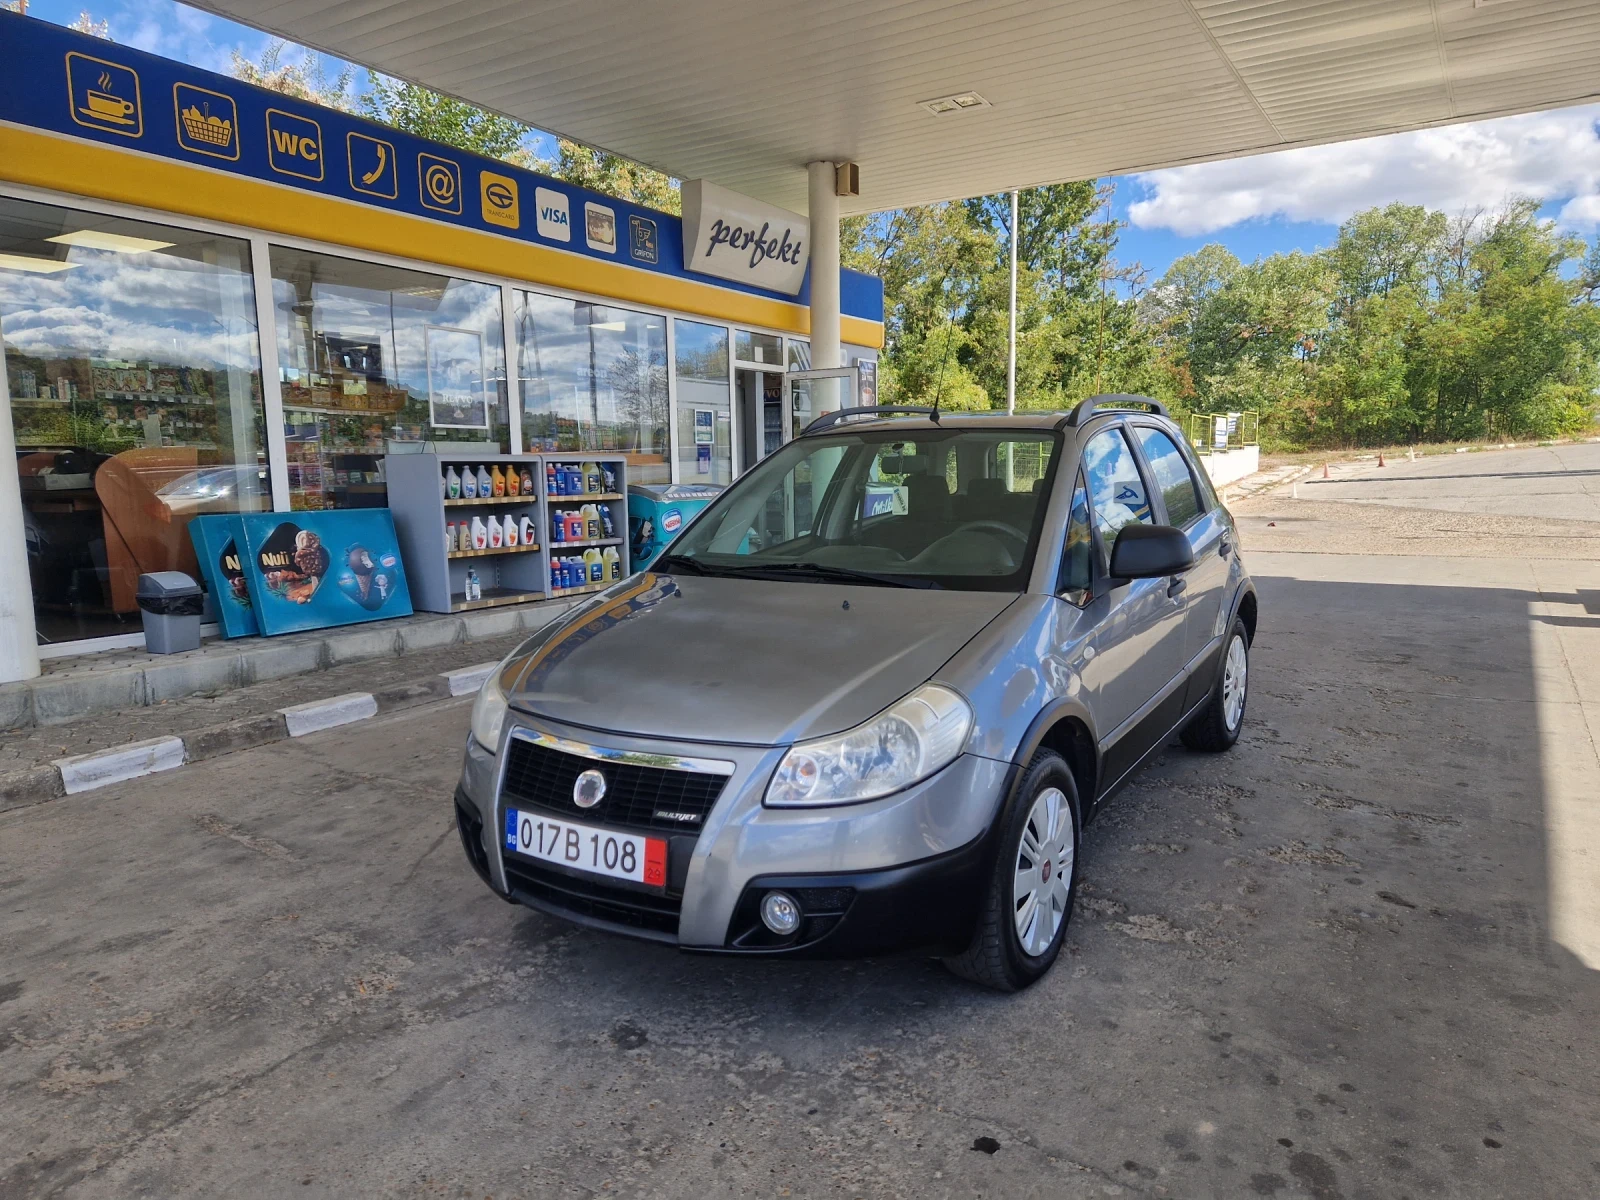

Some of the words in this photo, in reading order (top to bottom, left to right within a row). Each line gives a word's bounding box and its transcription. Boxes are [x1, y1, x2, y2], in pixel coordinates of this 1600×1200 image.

[273, 129, 318, 161] WC
[486, 208, 515, 221] TRANSCARD
[541, 206, 568, 226] VISA
[705, 219, 802, 269] perfekt
[871, 495, 893, 516] Milk
[507, 833, 517, 845] BG
